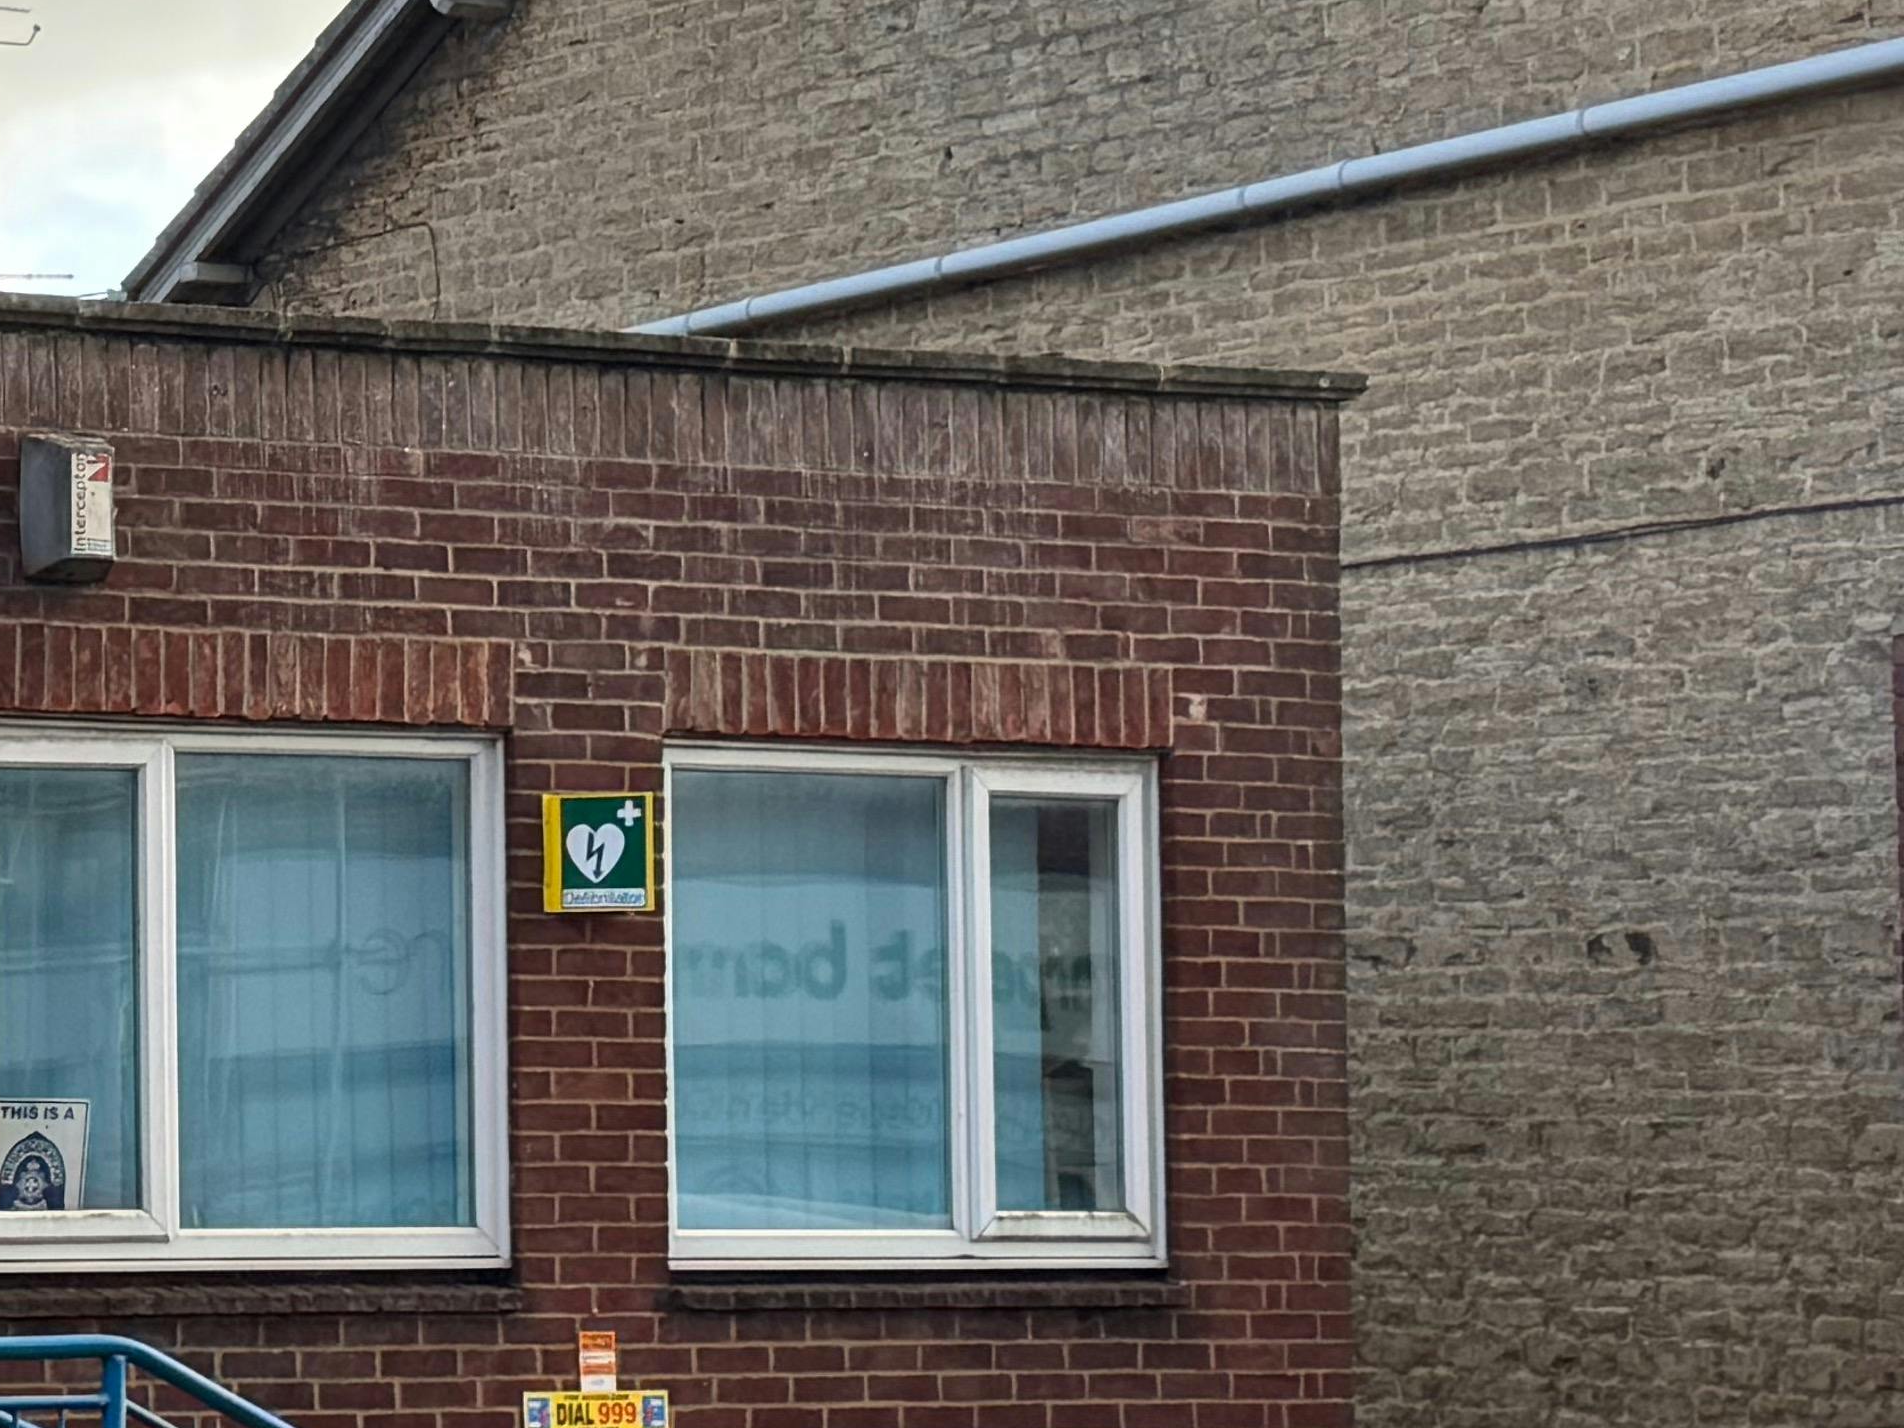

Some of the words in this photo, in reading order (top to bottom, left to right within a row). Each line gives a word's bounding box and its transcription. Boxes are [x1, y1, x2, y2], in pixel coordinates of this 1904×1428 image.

[0, 1106, 39, 1120] THIS
[44, 1106, 59, 1120] IS
[63, 1107, 74, 1120] A
[556, 1402, 594, 1426] DIAL
[598, 1401, 637, 1424] 999
